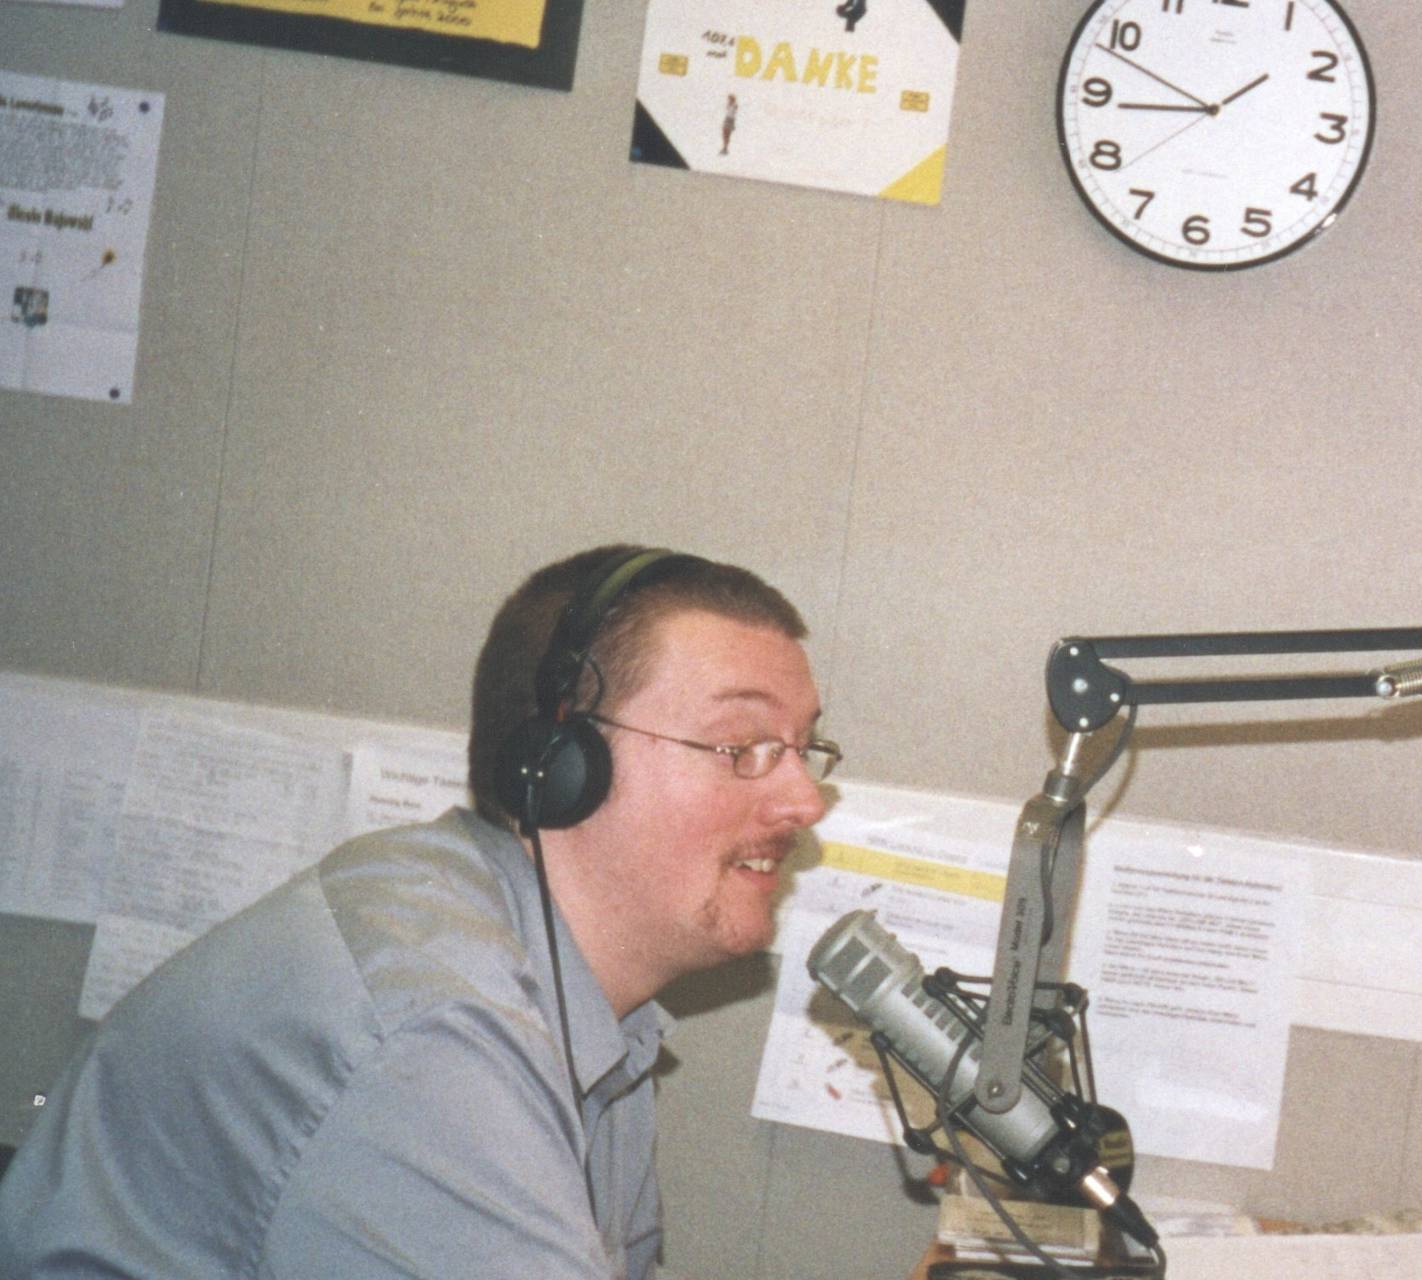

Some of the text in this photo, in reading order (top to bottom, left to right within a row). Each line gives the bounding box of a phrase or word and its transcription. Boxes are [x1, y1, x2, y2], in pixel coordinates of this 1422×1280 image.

[1284, 1, 1294, 31] 1
[1110, 20, 1141, 51] 10
[735, 35, 879, 93] DANKE
[1306, 50, 1338, 82] 2
[1081, 77, 1112, 108] 9
[1314, 112, 1348, 144] 3
[1089, 140, 1122, 171] 8
[1289, 172, 1318, 202] 4
[1128, 188, 1155, 220] 7
[1181, 216, 1211, 246] 6
[1241, 208, 1272, 238] 5
